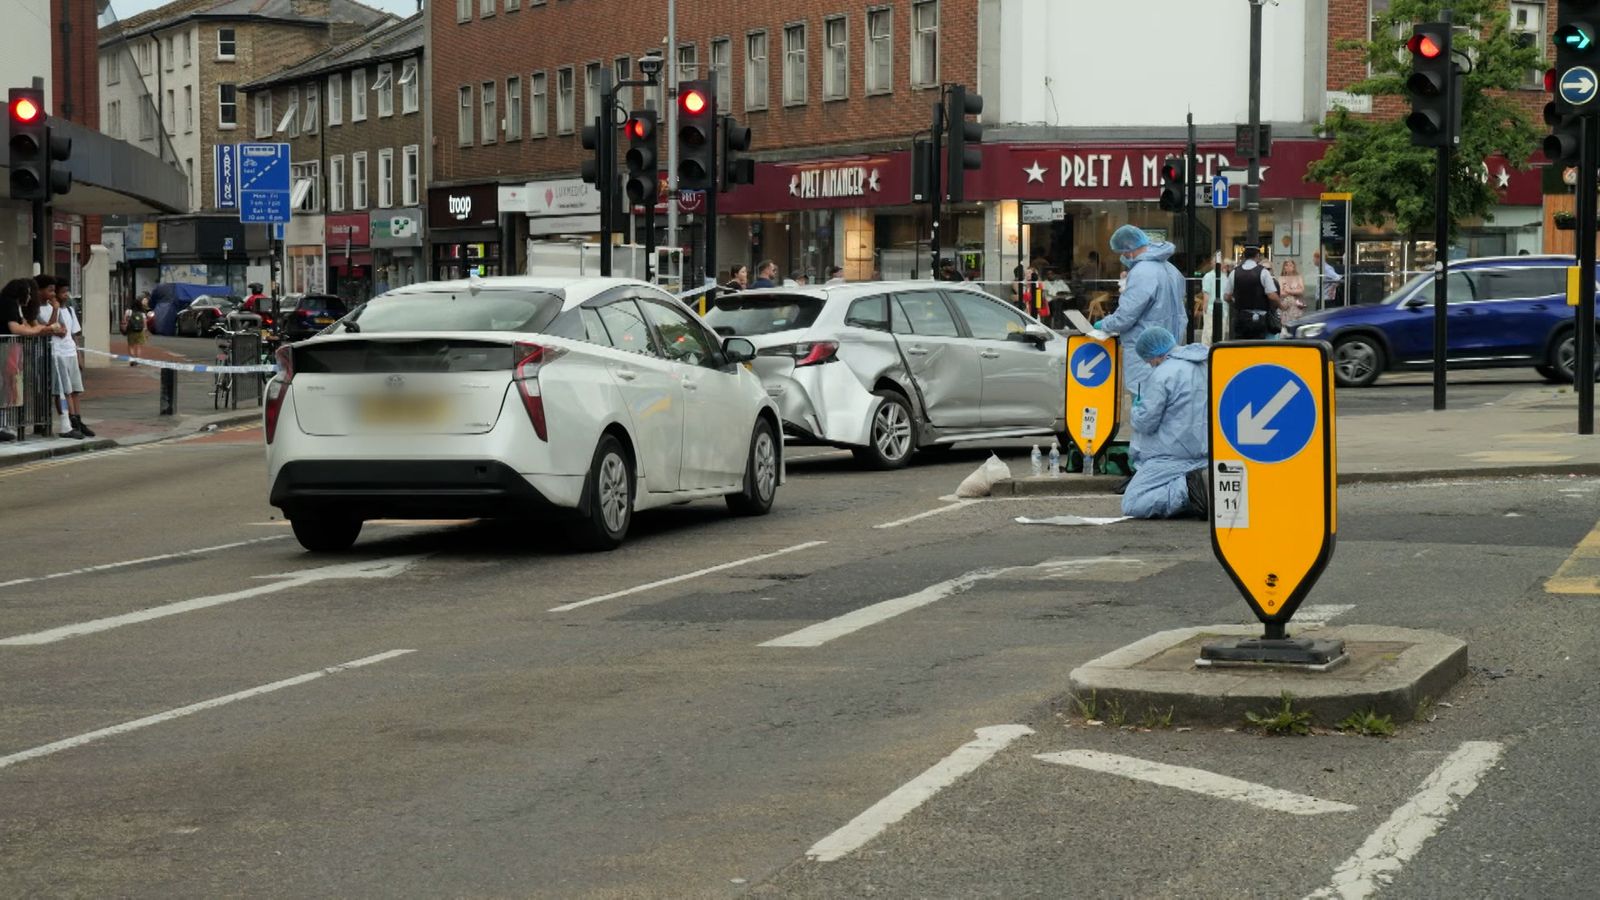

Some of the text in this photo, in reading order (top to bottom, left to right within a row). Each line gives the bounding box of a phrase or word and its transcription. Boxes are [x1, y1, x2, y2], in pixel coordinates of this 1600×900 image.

[223, 145, 232, 200] PARKING
[801, 167, 866, 198] PRET A MANGER
[1060, 154, 1112, 187] PRET
[1119, 154, 1133, 187] A
[449, 195, 471, 218] troop
[1224, 498, 1237, 510] 11
